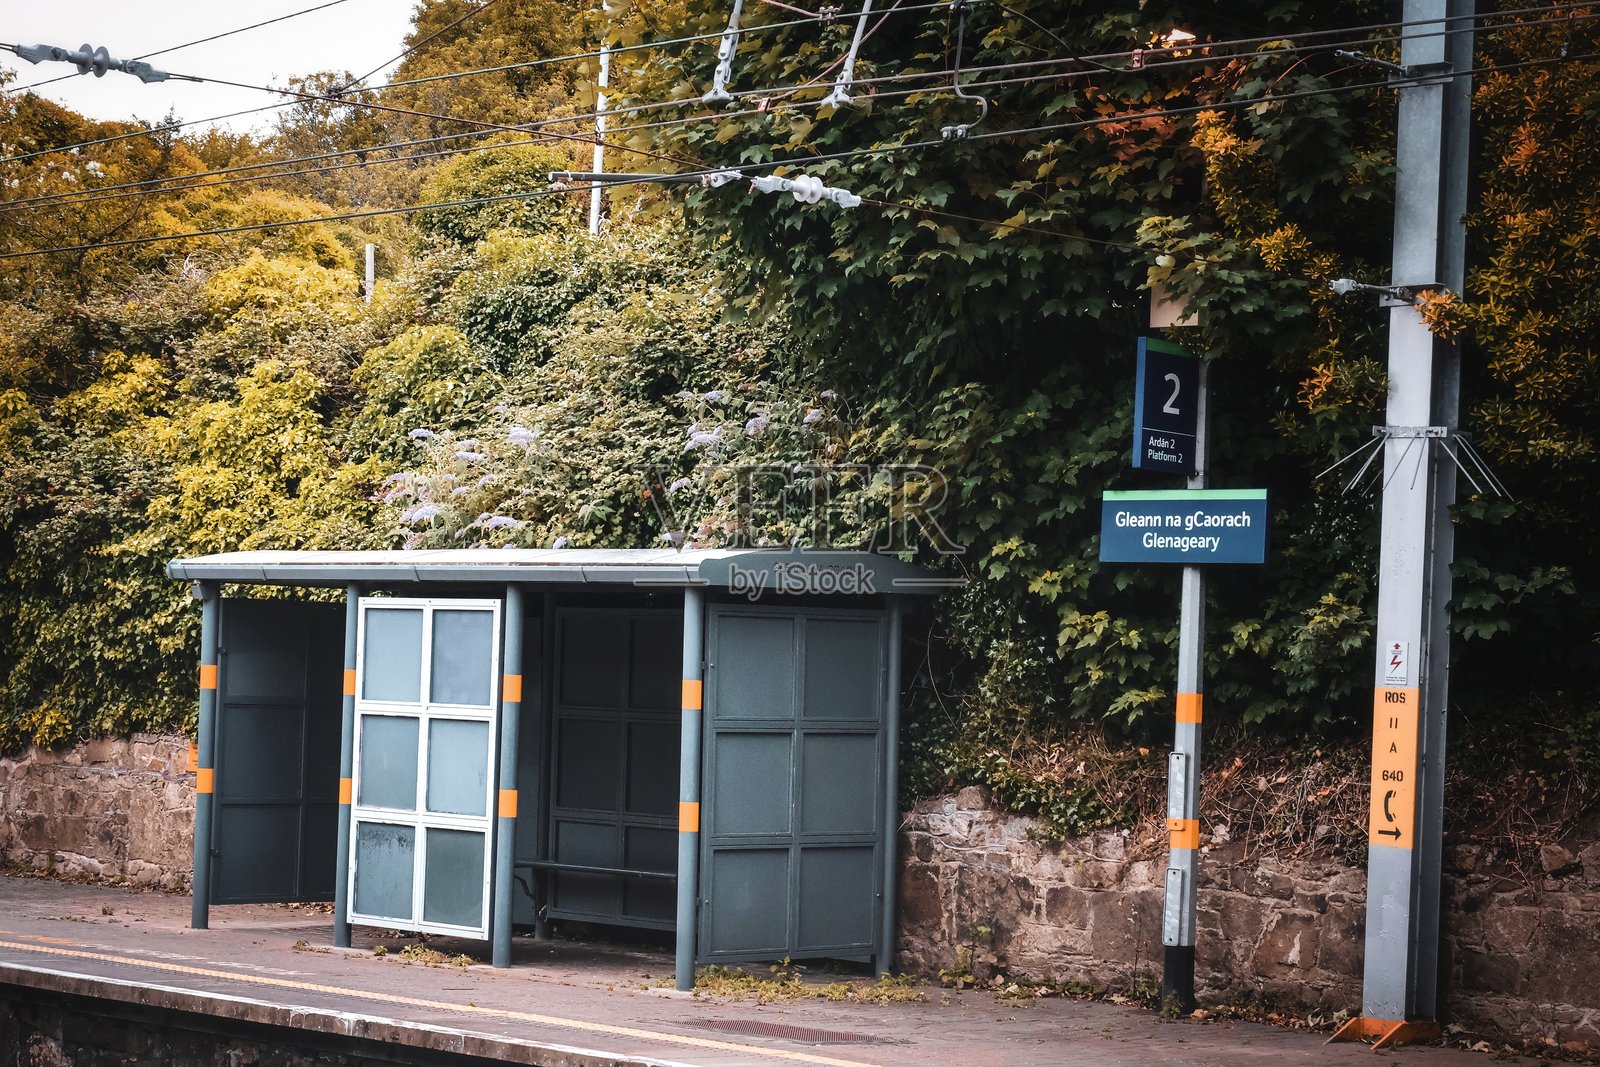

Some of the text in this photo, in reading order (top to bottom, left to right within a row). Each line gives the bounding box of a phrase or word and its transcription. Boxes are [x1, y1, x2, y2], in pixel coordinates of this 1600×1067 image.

[1163, 372, 1181, 415] 2
[1148, 435, 1176, 450] Ardán 2
[1147, 448, 1183, 464] Platform 2
[1115, 511, 1251, 531] Gleann na gCaorach
[1142, 532, 1220, 552] Glenageary
[1385, 691, 1406, 704] ROS
[1389, 742, 1397, 753] A
[1382, 770, 1403, 782] 640
